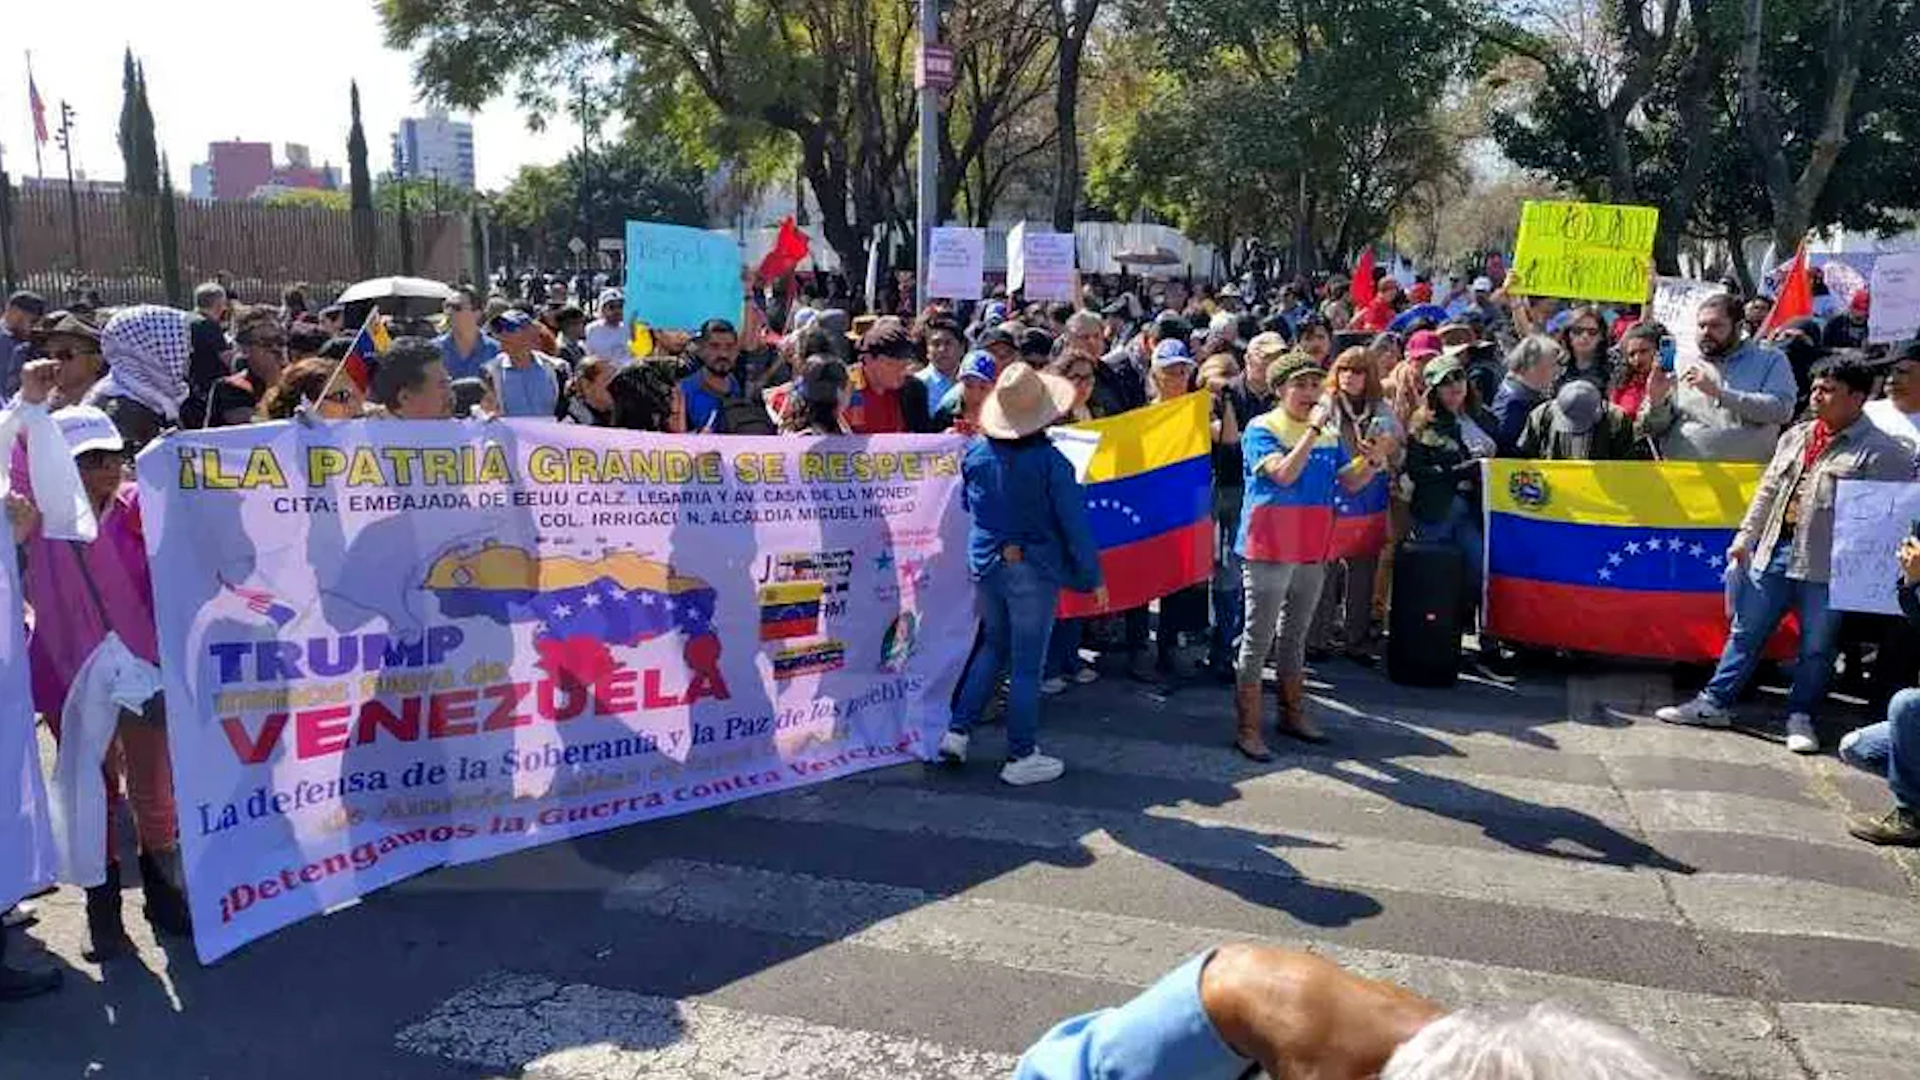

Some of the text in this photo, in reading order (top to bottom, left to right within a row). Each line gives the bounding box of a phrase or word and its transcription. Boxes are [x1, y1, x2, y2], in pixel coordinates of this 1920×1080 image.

[307, 446, 514, 489] PATRIA
[527, 445, 725, 485] GRANDE
[733, 451, 788, 484] SE
[274, 496, 338, 514] CITA:
[350, 492, 472, 512] EMBAJADA
[478, 491, 506, 508] DE
[514, 491, 569, 506] EEUU
[637, 490, 712, 505] LEGARIA
[715, 490, 727, 503] Y
[764, 489, 804, 503] CASA
[810, 488, 833, 502] DE
[838, 487, 857, 501] LA
[540, 512, 584, 528] COL.
[798, 505, 856, 522] MIGUEL
[210, 625, 464, 684] TRUMP
[221, 668, 731, 765] VENEZUELA
[198, 801, 239, 836] La
[247, 767, 388, 821] defensa
[402, 761, 446, 788] de
[459, 756, 488, 781] la
[666, 730, 683, 755] y
[692, 723, 714, 746] la
[723, 715, 771, 742] Paz
[776, 706, 805, 731] de
[490, 815, 526, 835] la
[537, 789, 666, 827] Guerra
[673, 768, 781, 802] contra
